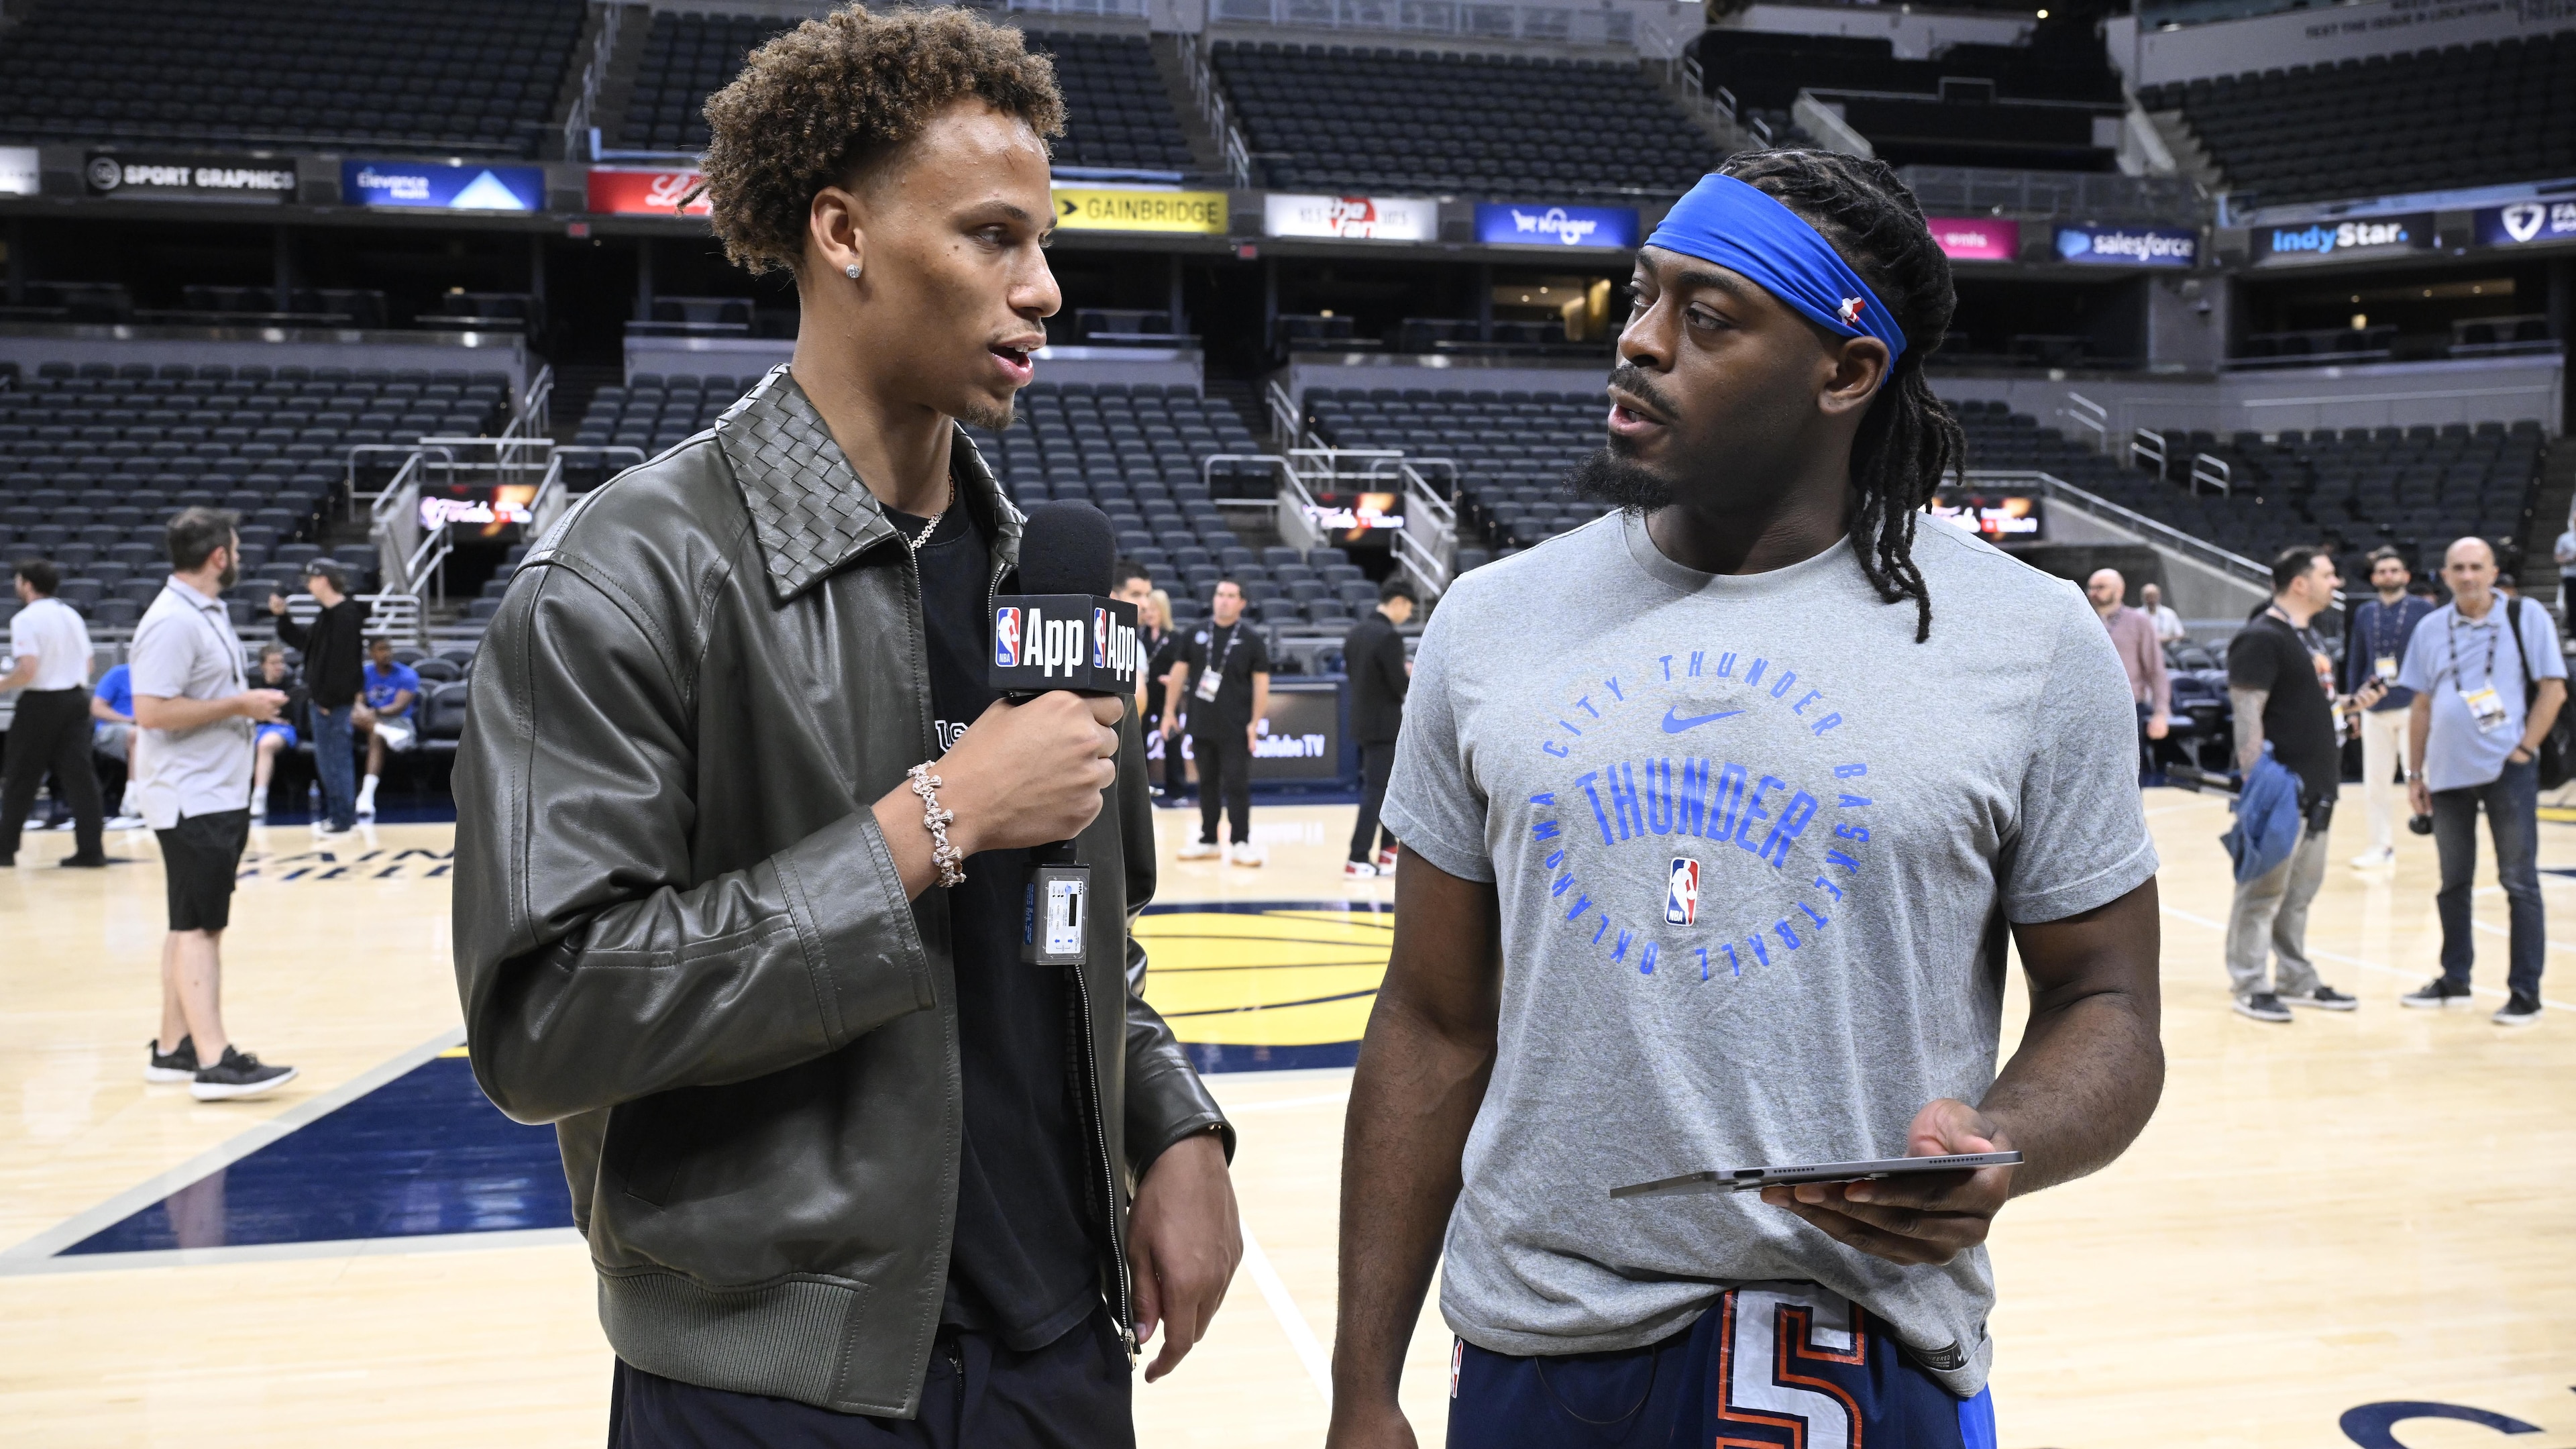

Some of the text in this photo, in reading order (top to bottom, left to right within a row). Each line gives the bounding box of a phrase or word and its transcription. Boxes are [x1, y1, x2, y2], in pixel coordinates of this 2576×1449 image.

[123, 165, 295, 190] SPORT GRAPHICS
[1087, 197, 1219, 225] GAINBRIDGE
[1538, 207, 1597, 246] Kroger
[2093, 231, 2194, 262] salesforce
[999, 653, 1010, 663] NBA
[1023, 608, 1085, 678] App
[1107, 611, 1136, 682] App
[1543, 676, 1624, 759] CITY
[1659, 651, 1843, 737] THUNDER
[1575, 757, 1818, 868] THUNDER
[1695, 762, 1872, 980] BASKETBALL
[1668, 909, 1683, 923] NBA
